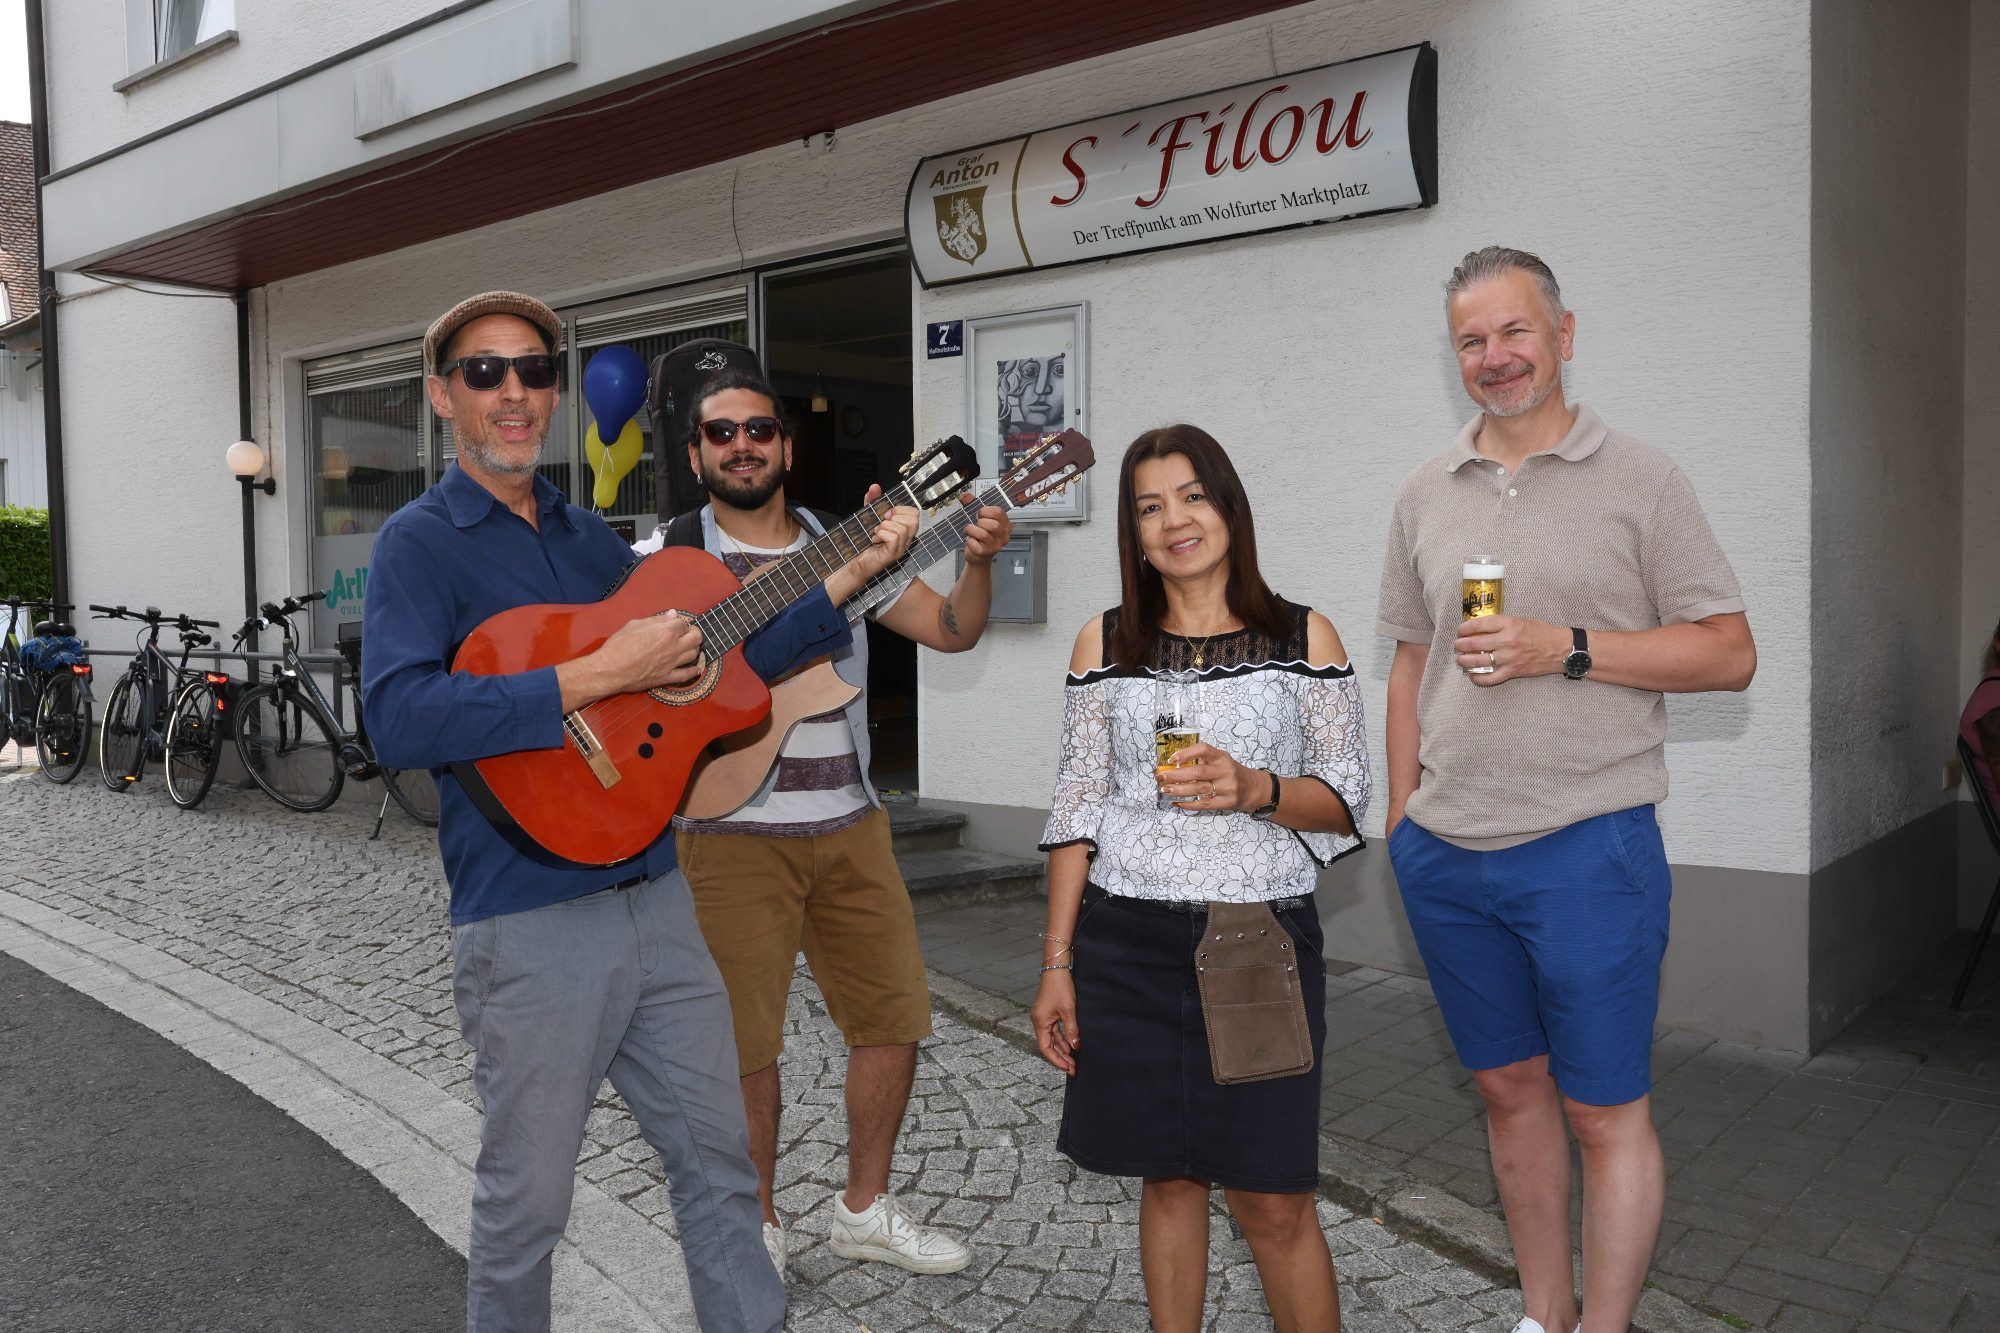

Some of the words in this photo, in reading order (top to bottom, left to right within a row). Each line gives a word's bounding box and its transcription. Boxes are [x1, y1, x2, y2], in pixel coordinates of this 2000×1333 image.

[957, 153, 984, 166] Graf
[929, 160, 999, 189] Anton
[1072, 229, 1099, 245] Der
[1100, 214, 1177, 239] Treffpunkt
[1179, 212, 1203, 227] am
[1203, 200, 1277, 222] Wolfurter
[1280, 181, 1371, 209] Marktplatz
[939, 324, 950, 346] 7
